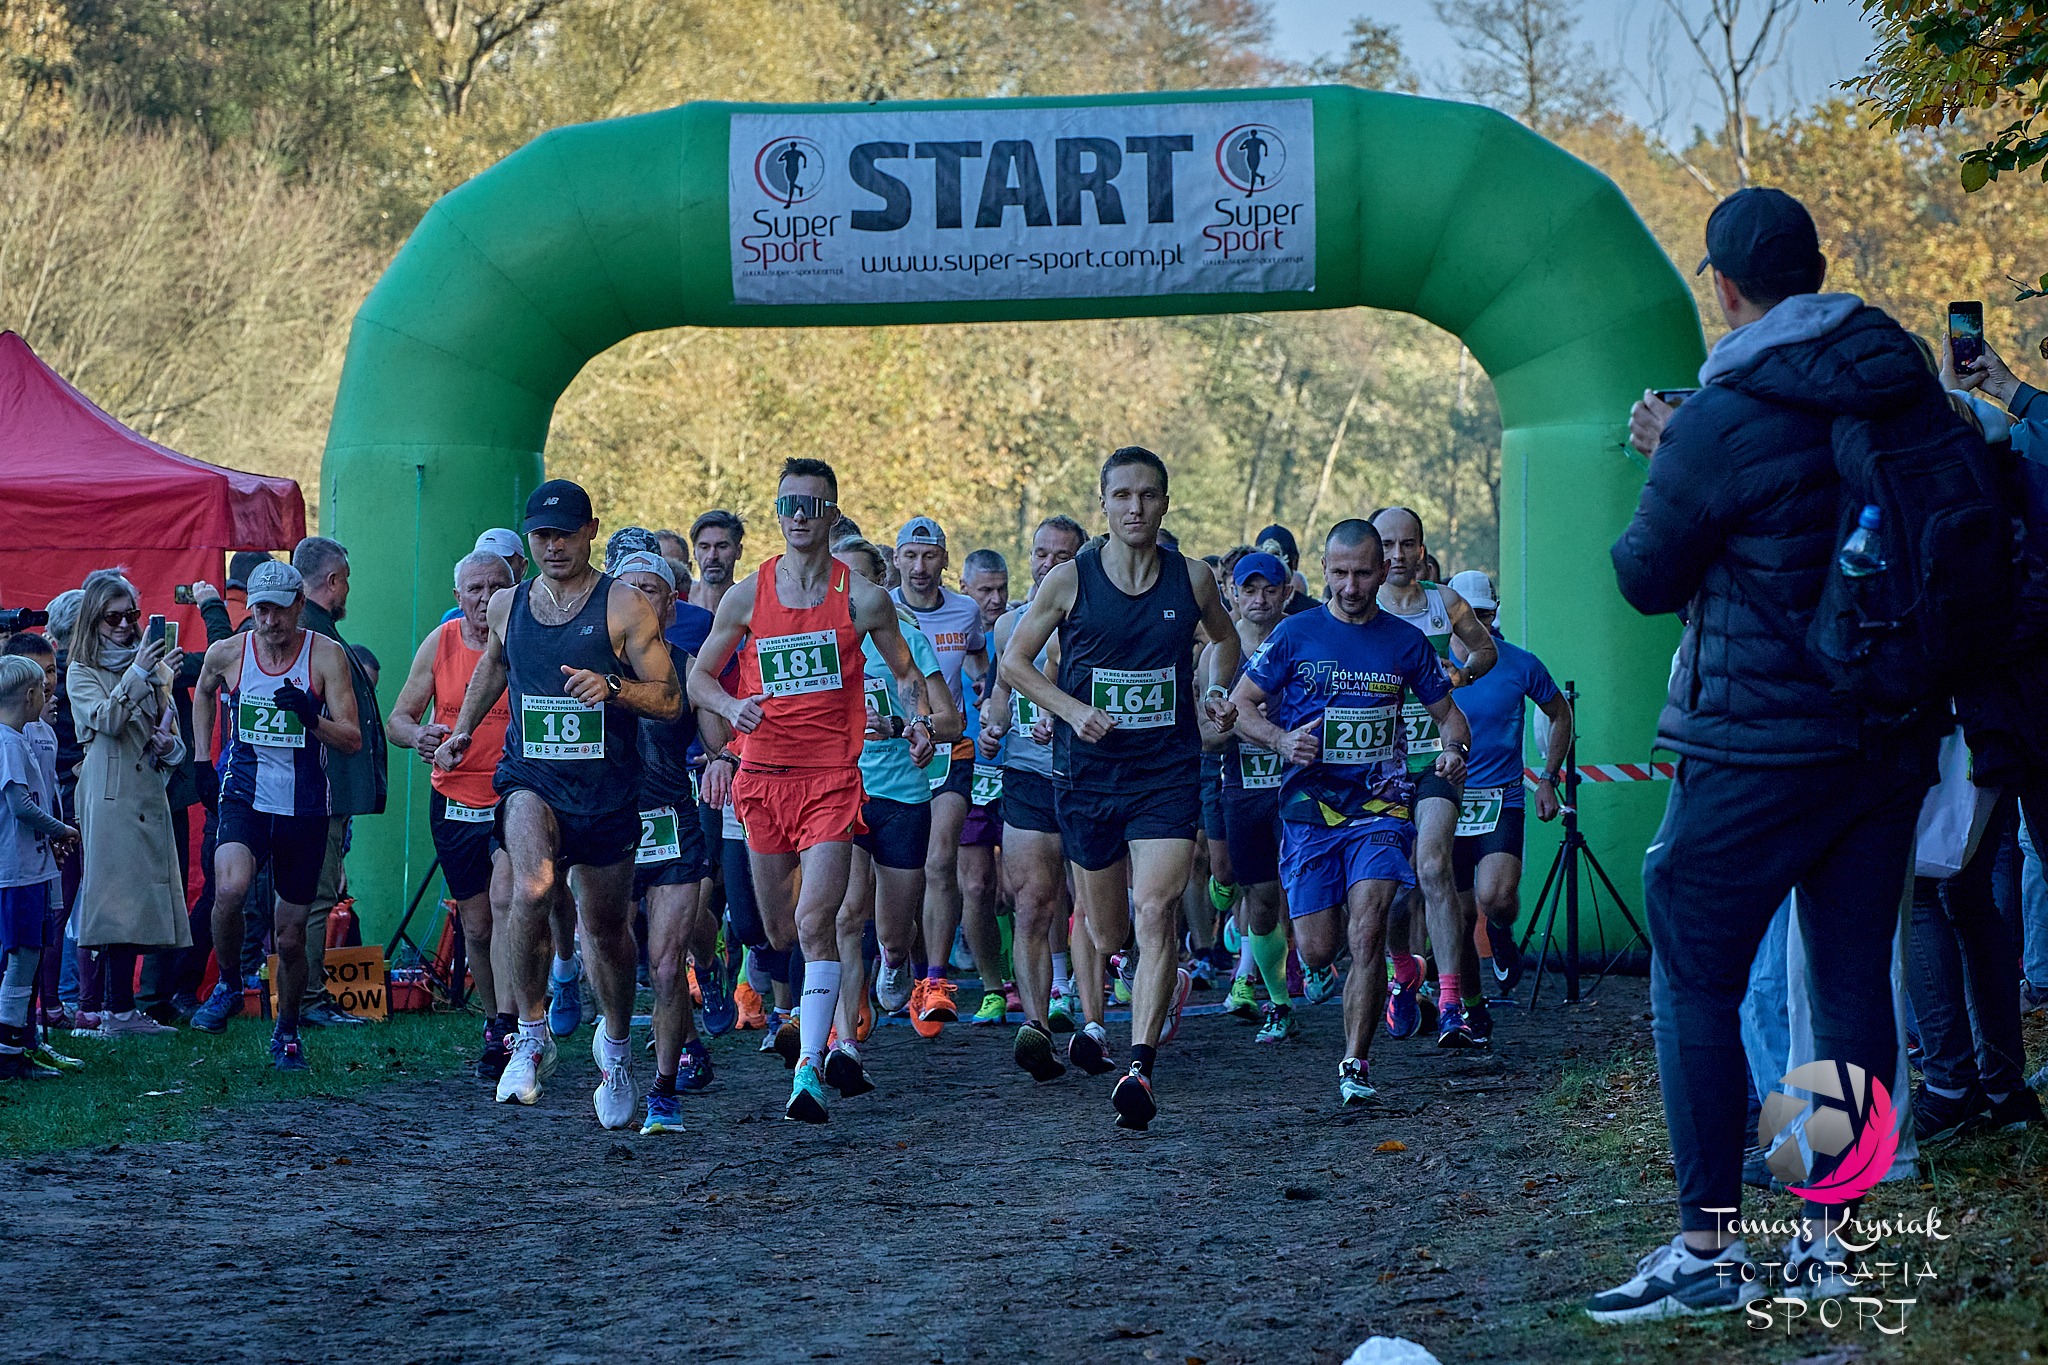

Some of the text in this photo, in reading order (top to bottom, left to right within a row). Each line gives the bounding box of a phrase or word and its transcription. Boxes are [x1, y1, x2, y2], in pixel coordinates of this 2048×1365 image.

[849, 134, 1193, 231] START
[753, 209, 842, 243] Super
[1215, 199, 1304, 232] Super
[741, 238, 823, 270] Sport
[1203, 226, 1284, 259] Sport
[861, 244, 1184, 275] www.super-sport.com.pl
[772, 647, 828, 680] 181
[1332, 669, 1403, 685] PÓŁMARATON
[1298, 661, 1338, 695] 37
[1332, 681, 1368, 691] SOLAN
[1028, 702, 1039, 722] 1
[1105, 685, 1164, 712] 164
[254, 708, 287, 733] 24
[542, 713, 581, 742] 18
[1336, 721, 1387, 748] 203
[1251, 754, 1284, 776] 17
[970, 776, 1003, 797] 47
[1458, 801, 1491, 823] 37
[324, 962, 374, 983] ROT
[332, 986, 382, 1011] ÓW
